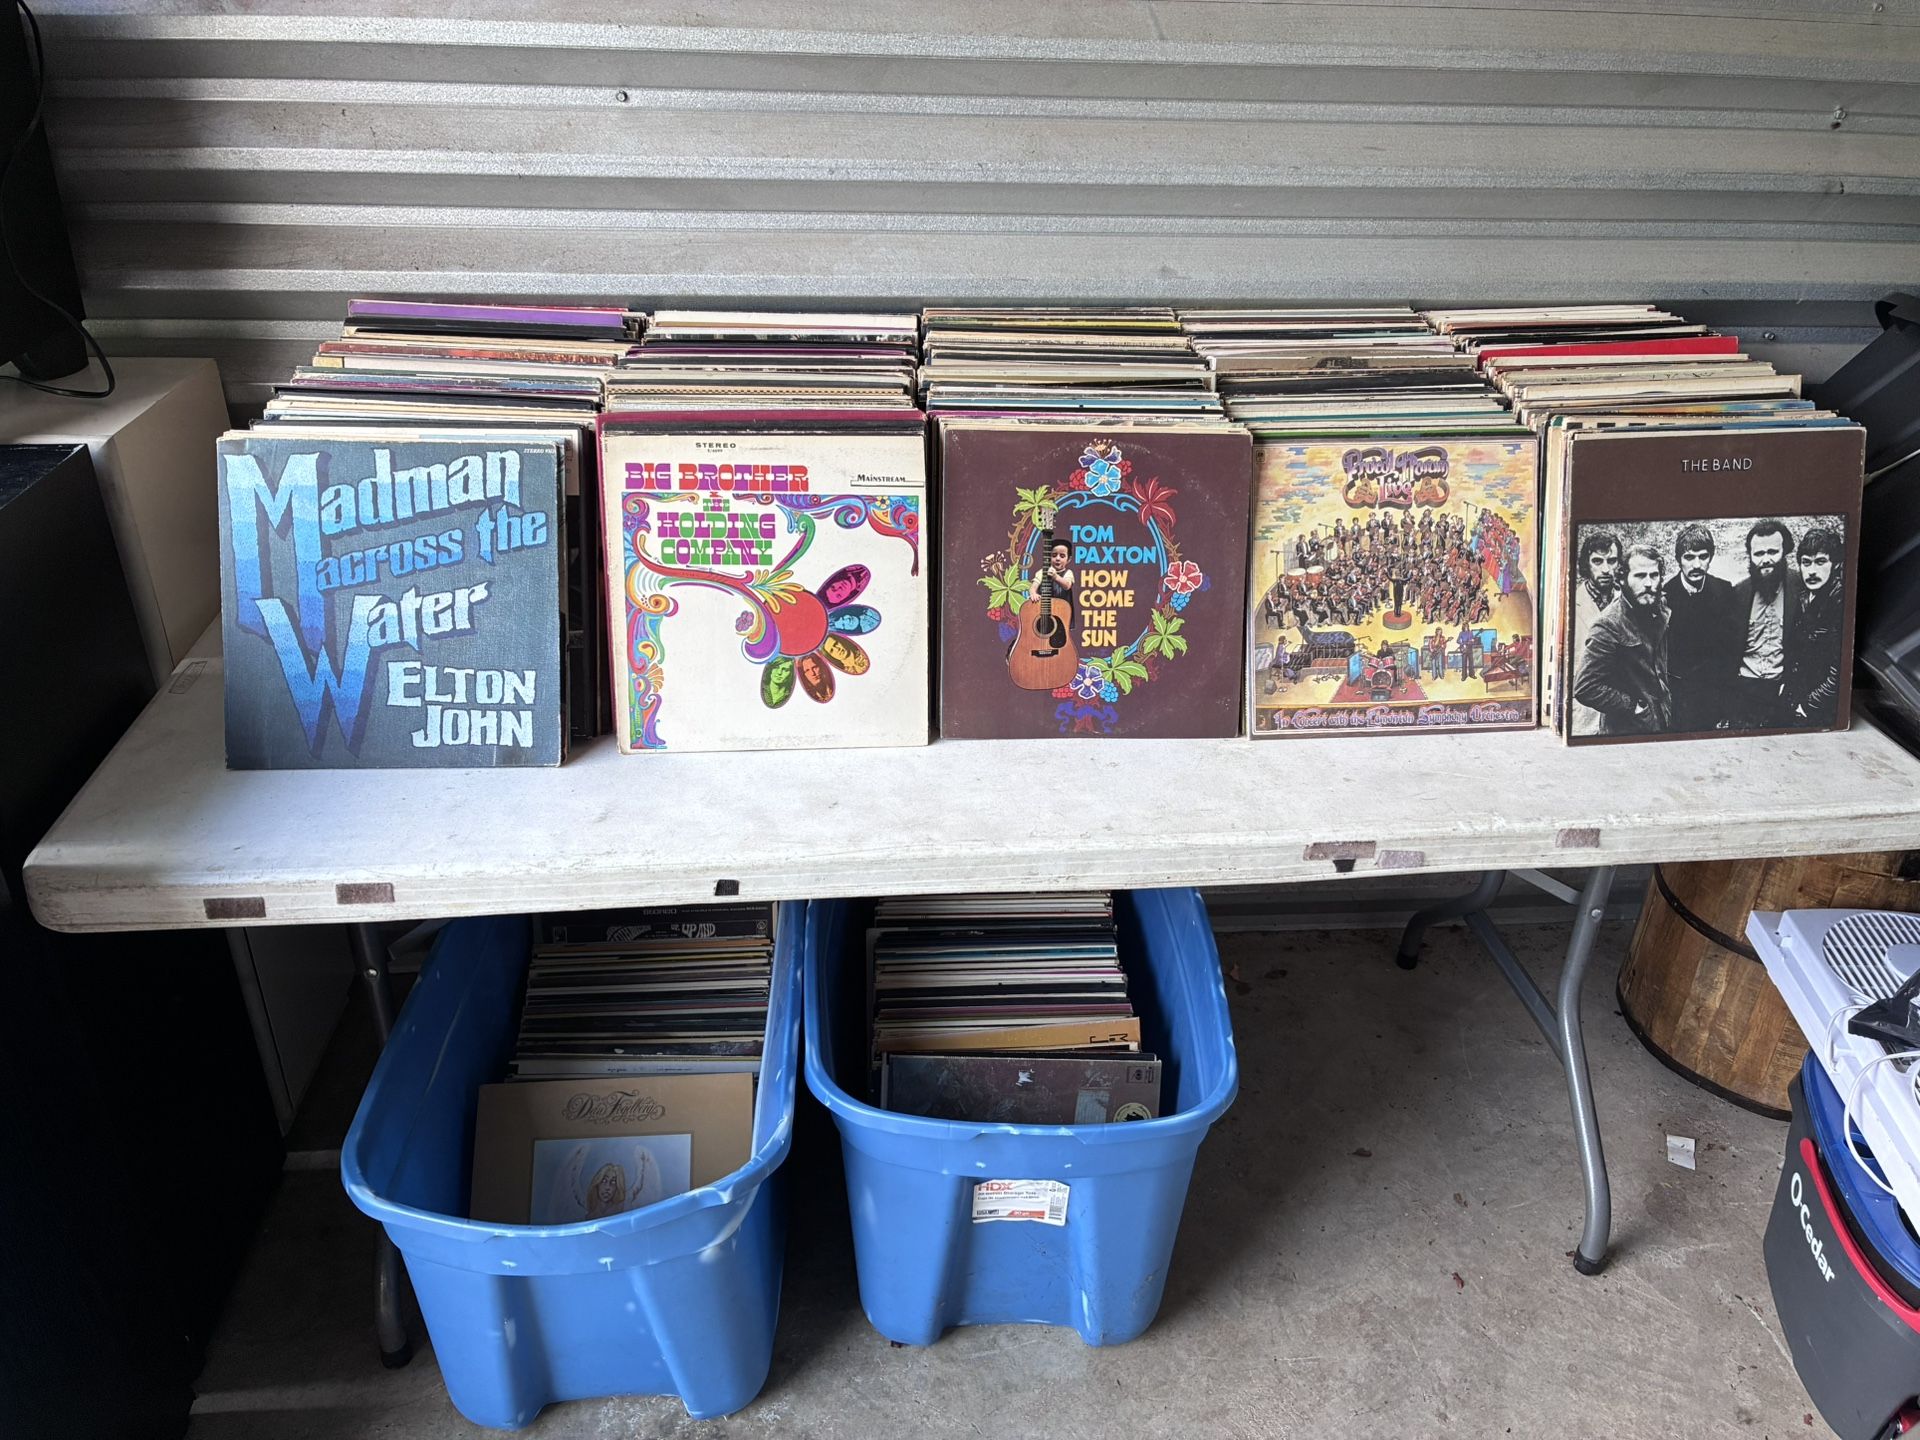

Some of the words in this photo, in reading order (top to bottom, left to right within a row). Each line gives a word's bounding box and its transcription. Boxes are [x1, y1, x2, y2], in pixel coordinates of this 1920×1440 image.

[1681, 459, 1709, 472] THE
[1712, 457, 1753, 471] BAND
[625, 462, 672, 490] BIG
[678, 463, 809, 492] BROTHER
[1376, 470, 1413, 506] Live
[657, 512, 776, 539] HOLDING
[1070, 525, 1114, 543] TOM
[223, 449, 521, 650] Madman
[316, 528, 463, 591] across
[475, 504, 548, 565] the
[661, 539, 773, 565] COMPANY
[1075, 546, 1157, 564] PAXTON
[1080, 570, 1128, 588] HOW
[1079, 590, 1135, 607] COME
[1081, 610, 1117, 627] THE
[1081, 630, 1117, 647] SUN
[255, 581, 491, 750] Water
[387, 660, 537, 707] ELTON
[411, 705, 533, 748] JOHN
[1273, 709, 1291, 730] In
[681, 923, 697, 938] UP
[696, 922, 716, 938] AND
[978, 1182, 1013, 1191] HDX
[1790, 1171, 1836, 1283] O-Cedar
